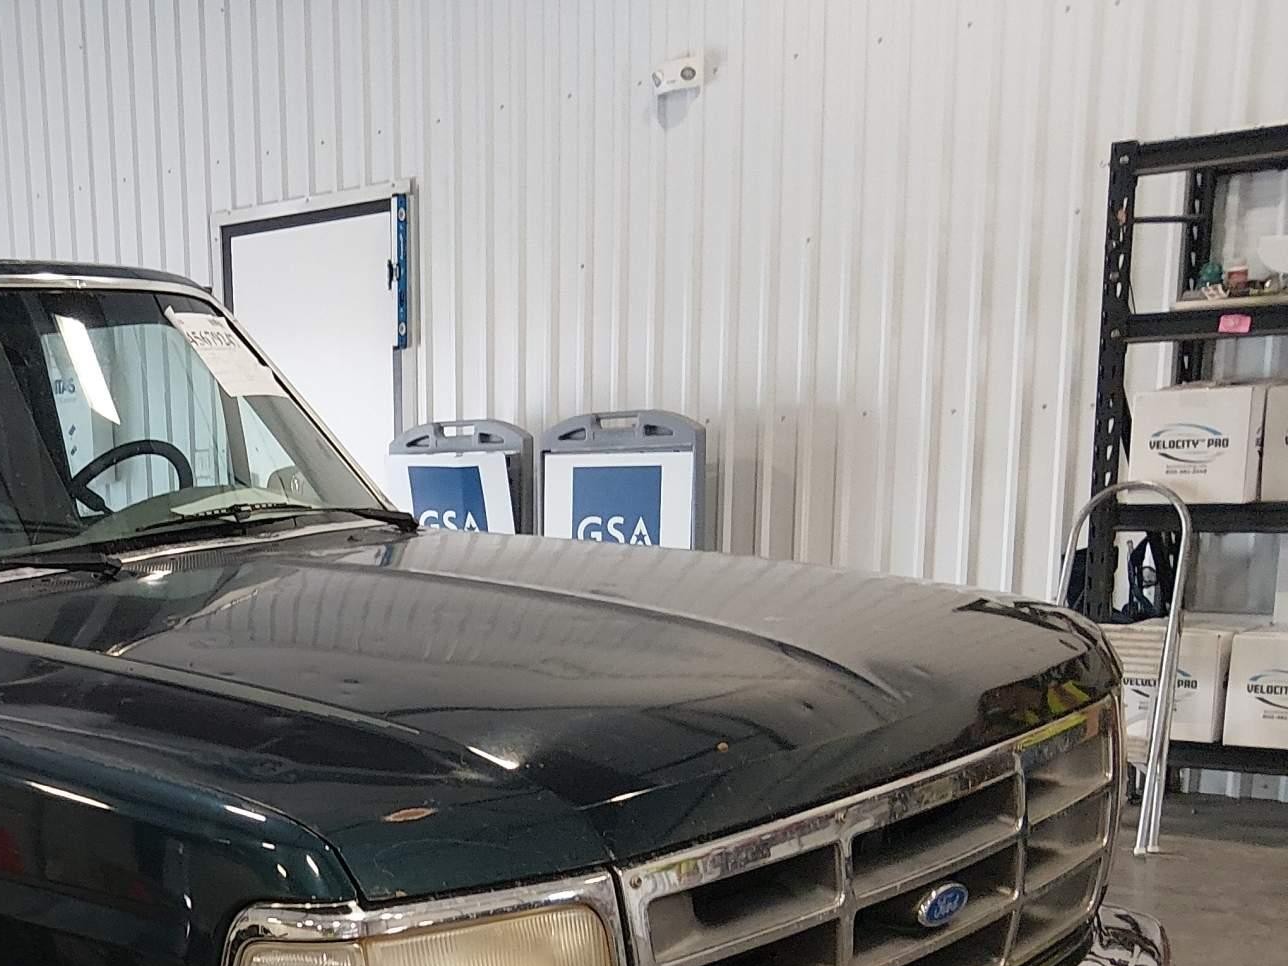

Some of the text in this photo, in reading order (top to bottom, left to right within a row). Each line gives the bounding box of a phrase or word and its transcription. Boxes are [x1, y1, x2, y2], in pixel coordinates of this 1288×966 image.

[1207, 438, 1229, 449] PRO
[419, 510, 480, 533] GSA
[577, 516, 653, 546] GSA
[1177, 679, 1198, 689] PRO
[1247, 684, 1288, 695] VELOCIT
